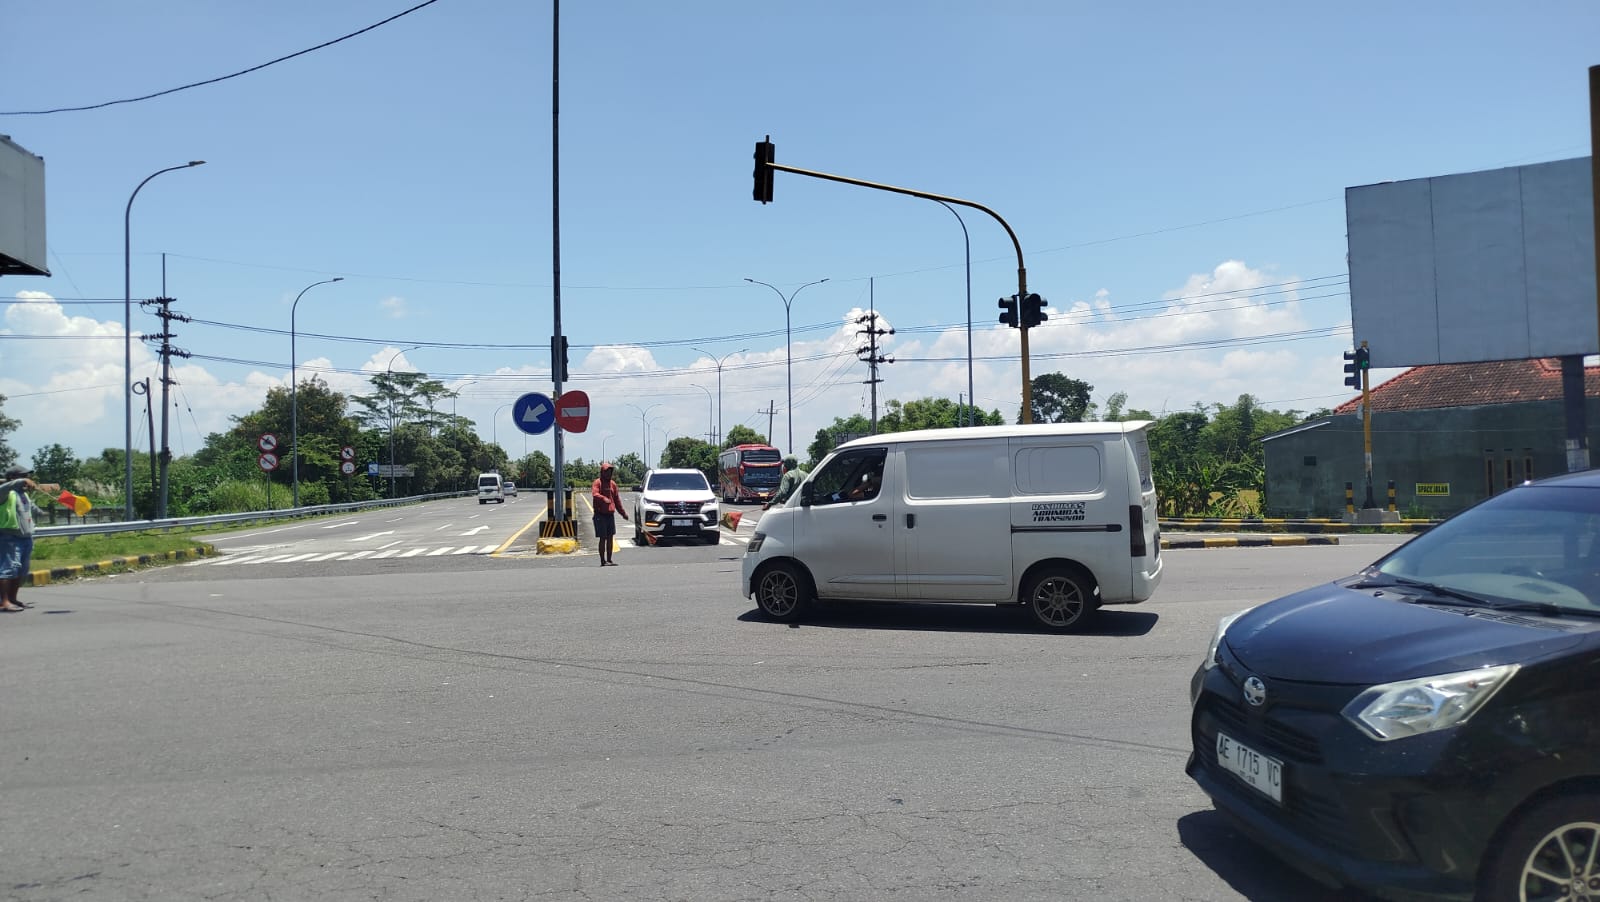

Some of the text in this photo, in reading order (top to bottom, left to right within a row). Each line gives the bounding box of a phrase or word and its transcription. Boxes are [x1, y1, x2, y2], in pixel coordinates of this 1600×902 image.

[1218, 735, 1230, 759] AE
[1237, 745, 1260, 775] 1715
[1266, 760, 1280, 787] VC
